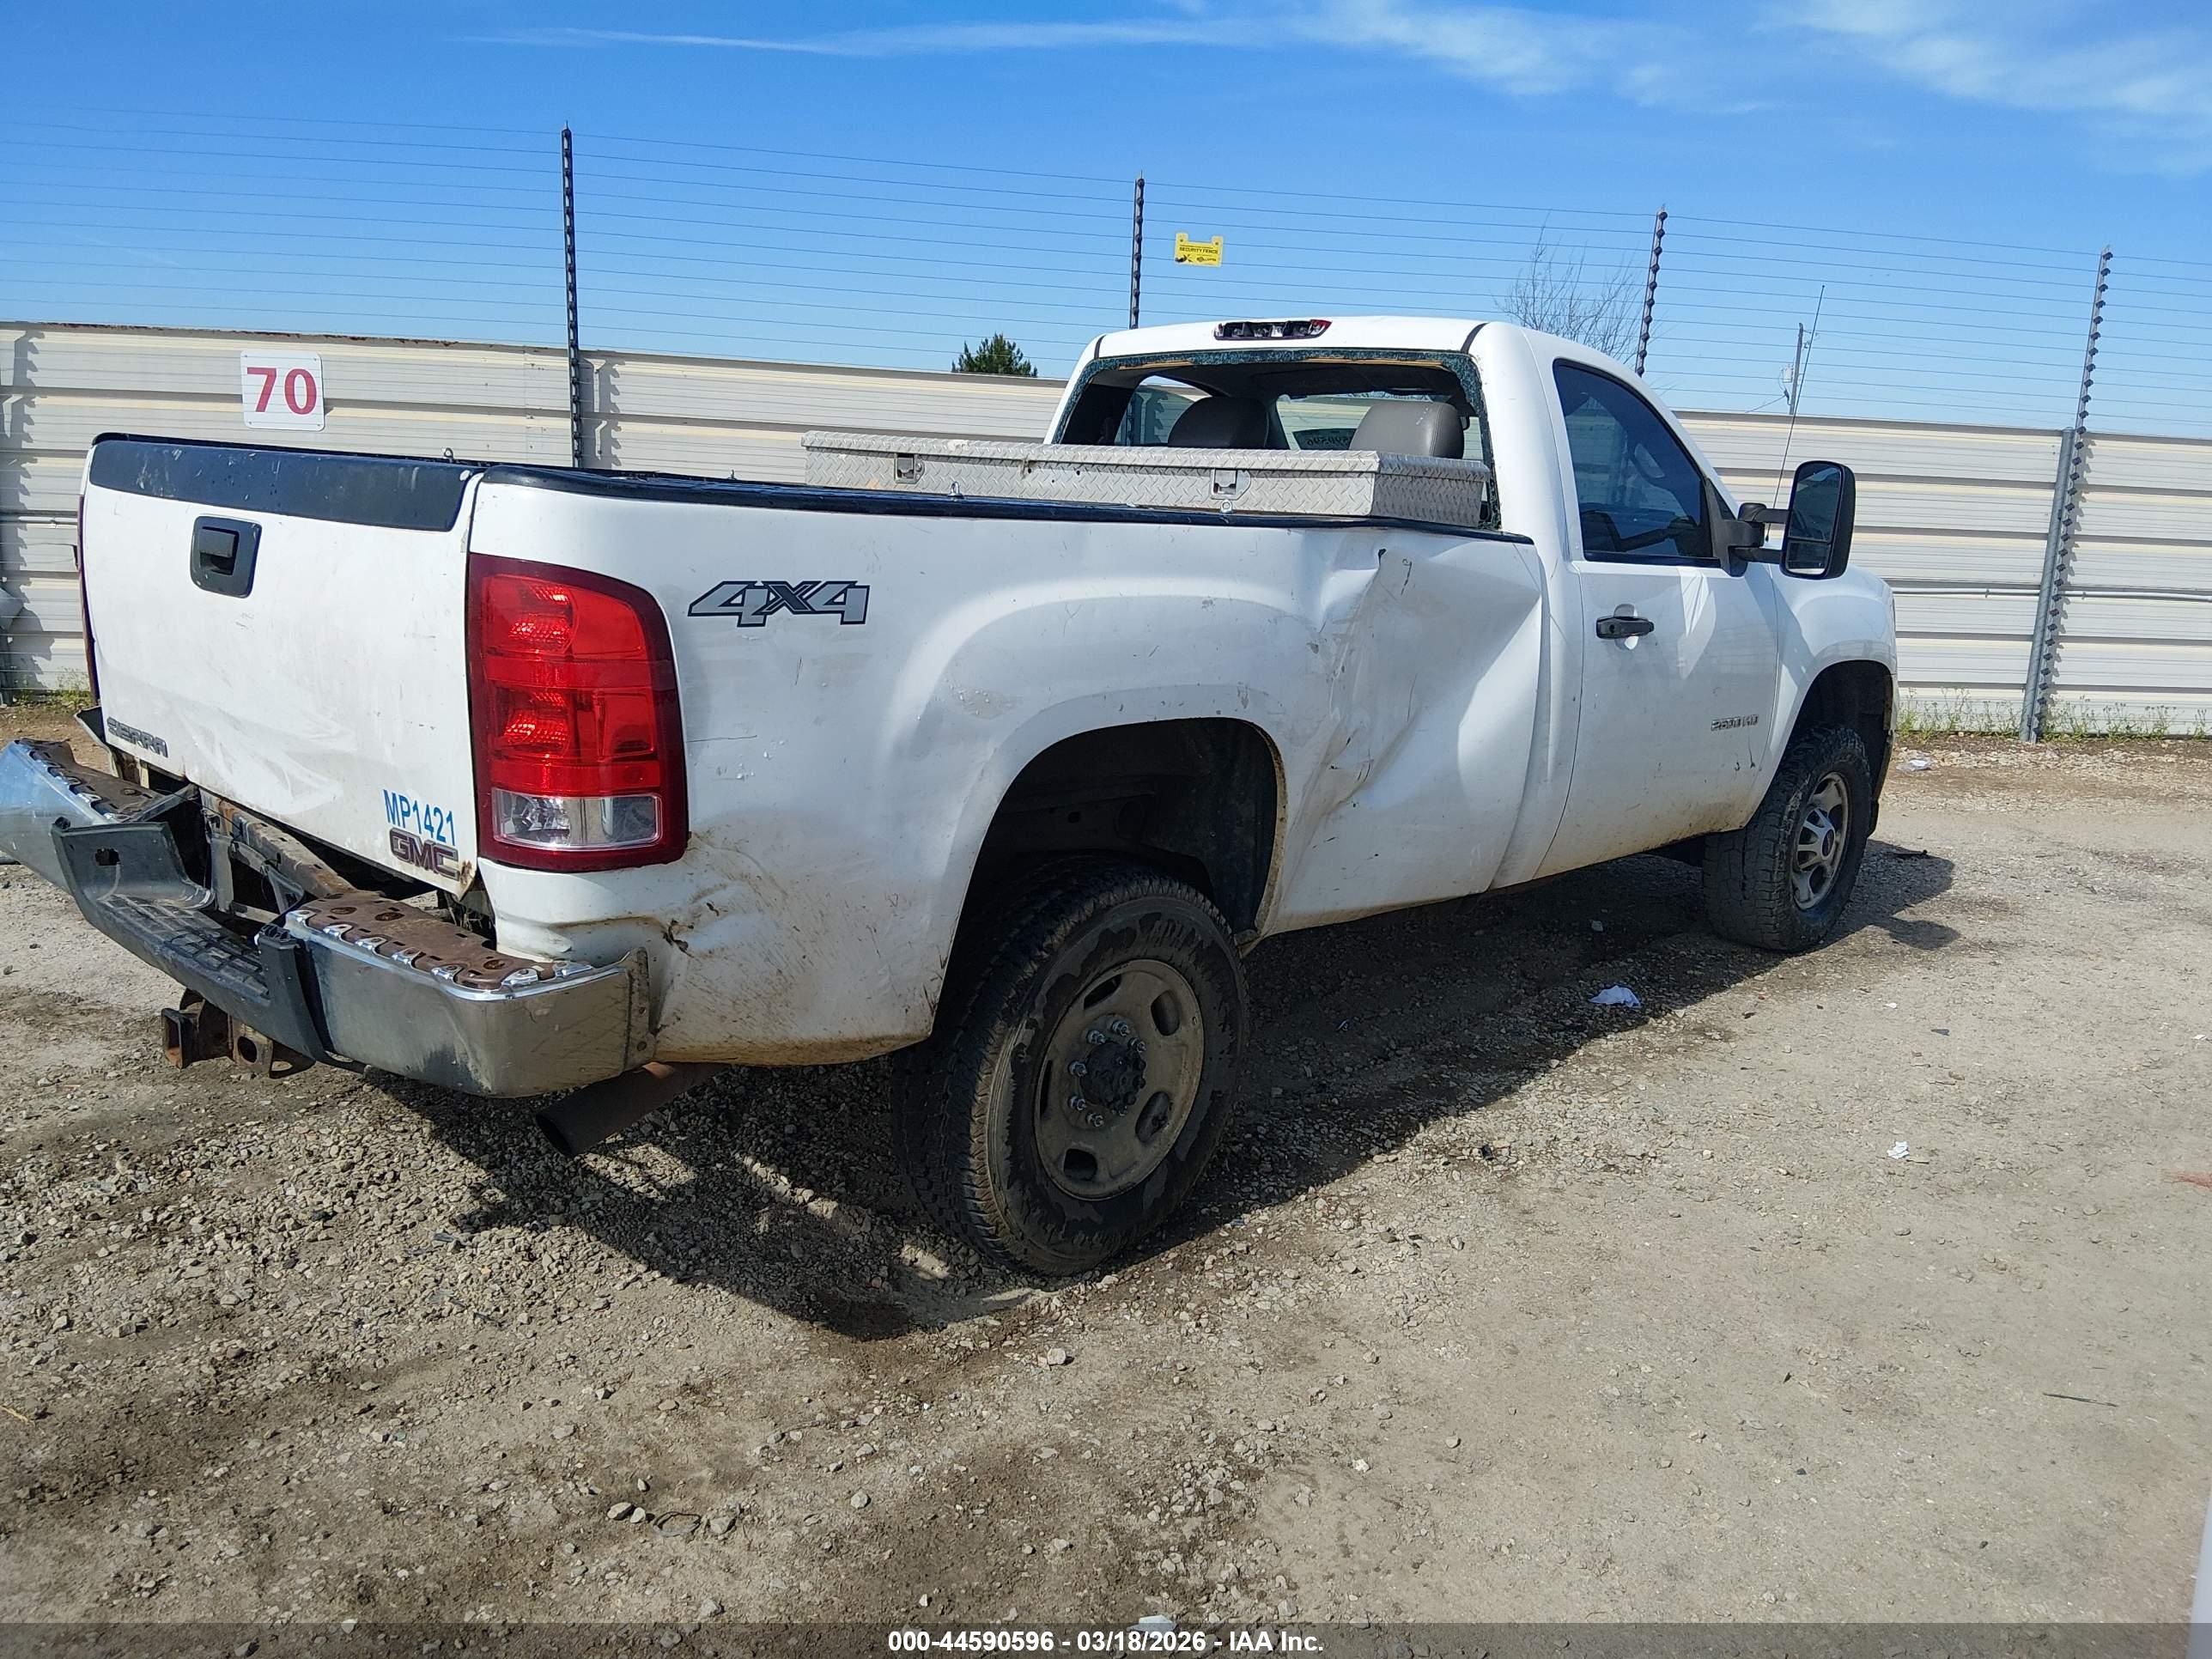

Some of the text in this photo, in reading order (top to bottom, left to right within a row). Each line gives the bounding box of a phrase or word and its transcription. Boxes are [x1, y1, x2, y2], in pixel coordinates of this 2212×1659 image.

[246, 367, 317, 415] 70
[687, 580, 871, 628] 4X4
[106, 716, 169, 758] SIERRA
[383, 788, 456, 847] MP1421
[389, 826, 461, 882] GMC
